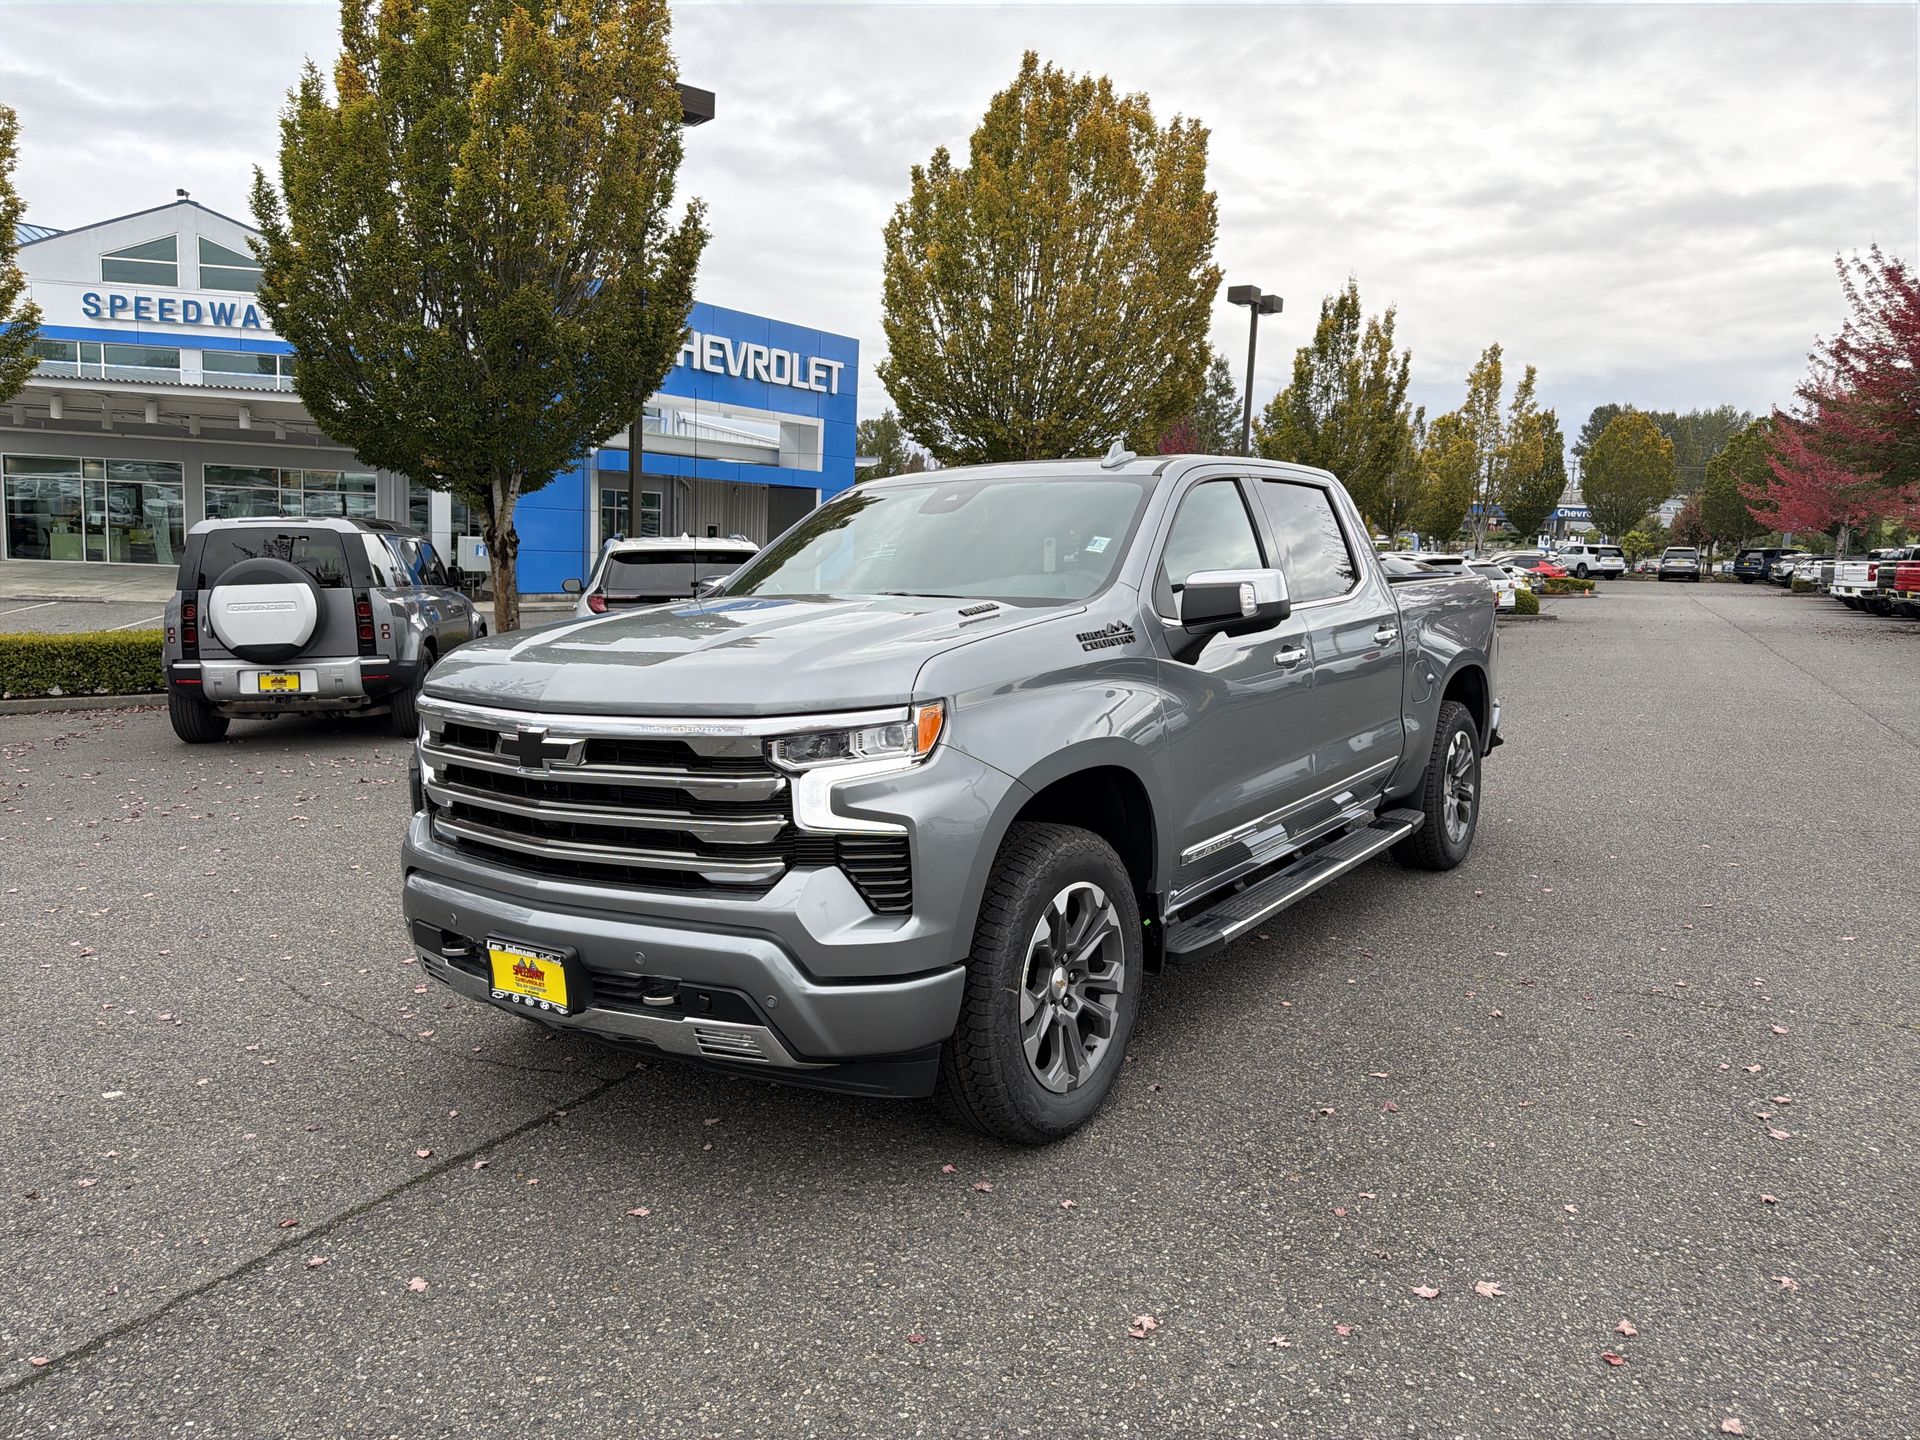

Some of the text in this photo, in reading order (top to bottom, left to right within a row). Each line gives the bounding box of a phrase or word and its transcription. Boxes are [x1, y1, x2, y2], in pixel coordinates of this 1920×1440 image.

[82, 292, 262, 329] SPEEDWA
[677, 329, 844, 395] HEVROLET
[1557, 508, 1593, 518] Chevro
[1075, 629, 1107, 643] HIGH
[1081, 633, 1137, 652] COUNTRY
